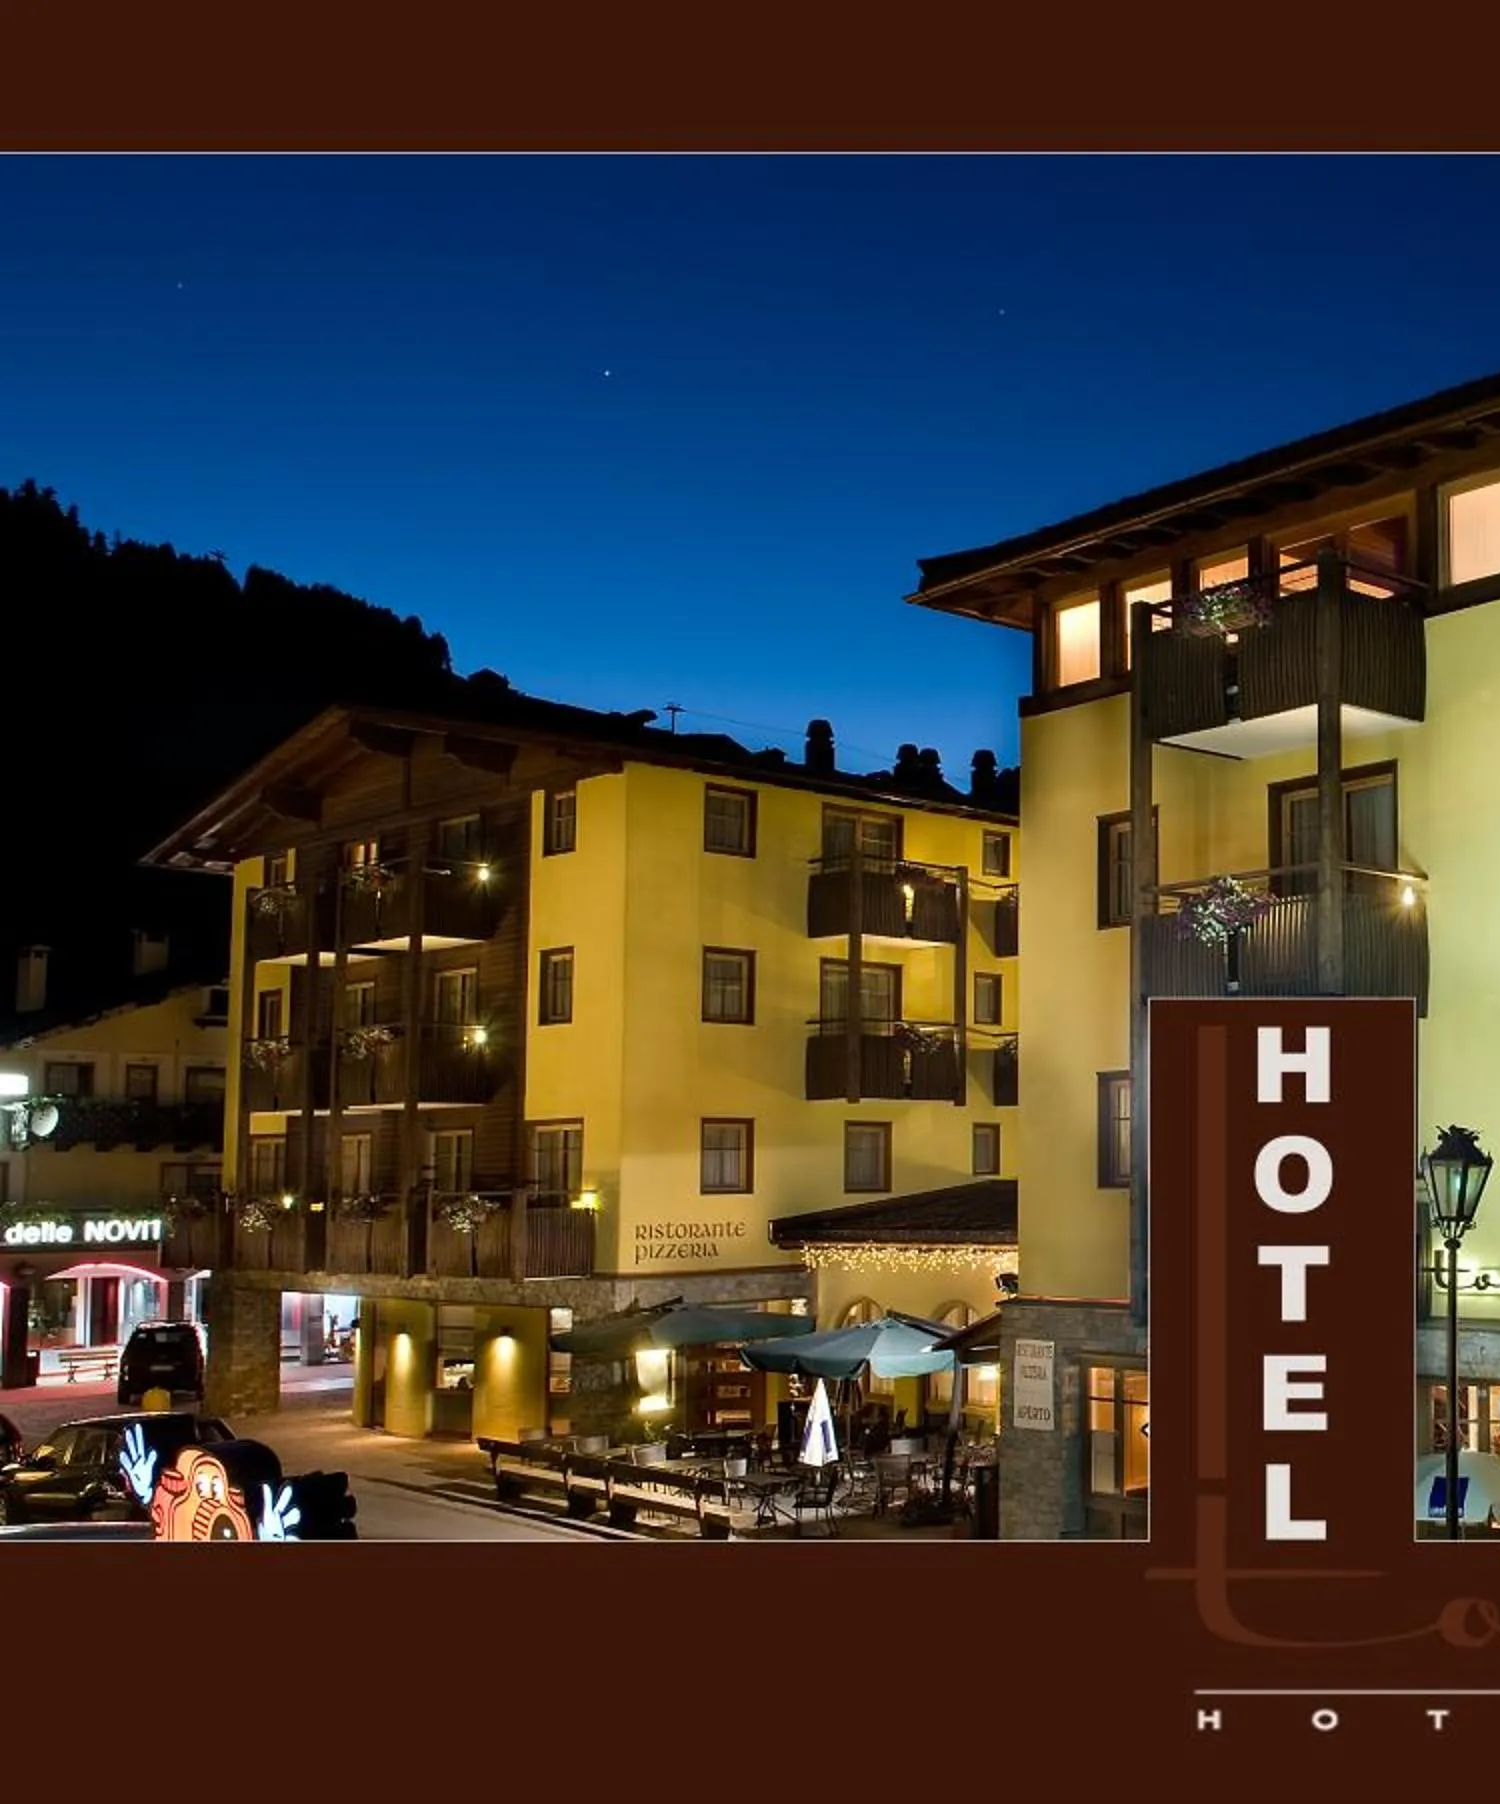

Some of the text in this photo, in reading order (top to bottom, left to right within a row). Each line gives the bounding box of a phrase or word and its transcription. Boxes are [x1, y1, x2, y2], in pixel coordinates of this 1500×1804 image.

[5, 1222, 73, 1244] delle
[635, 1221, 746, 1240] RISTORANTE
[635, 1242, 719, 1265] PIZZERIA
